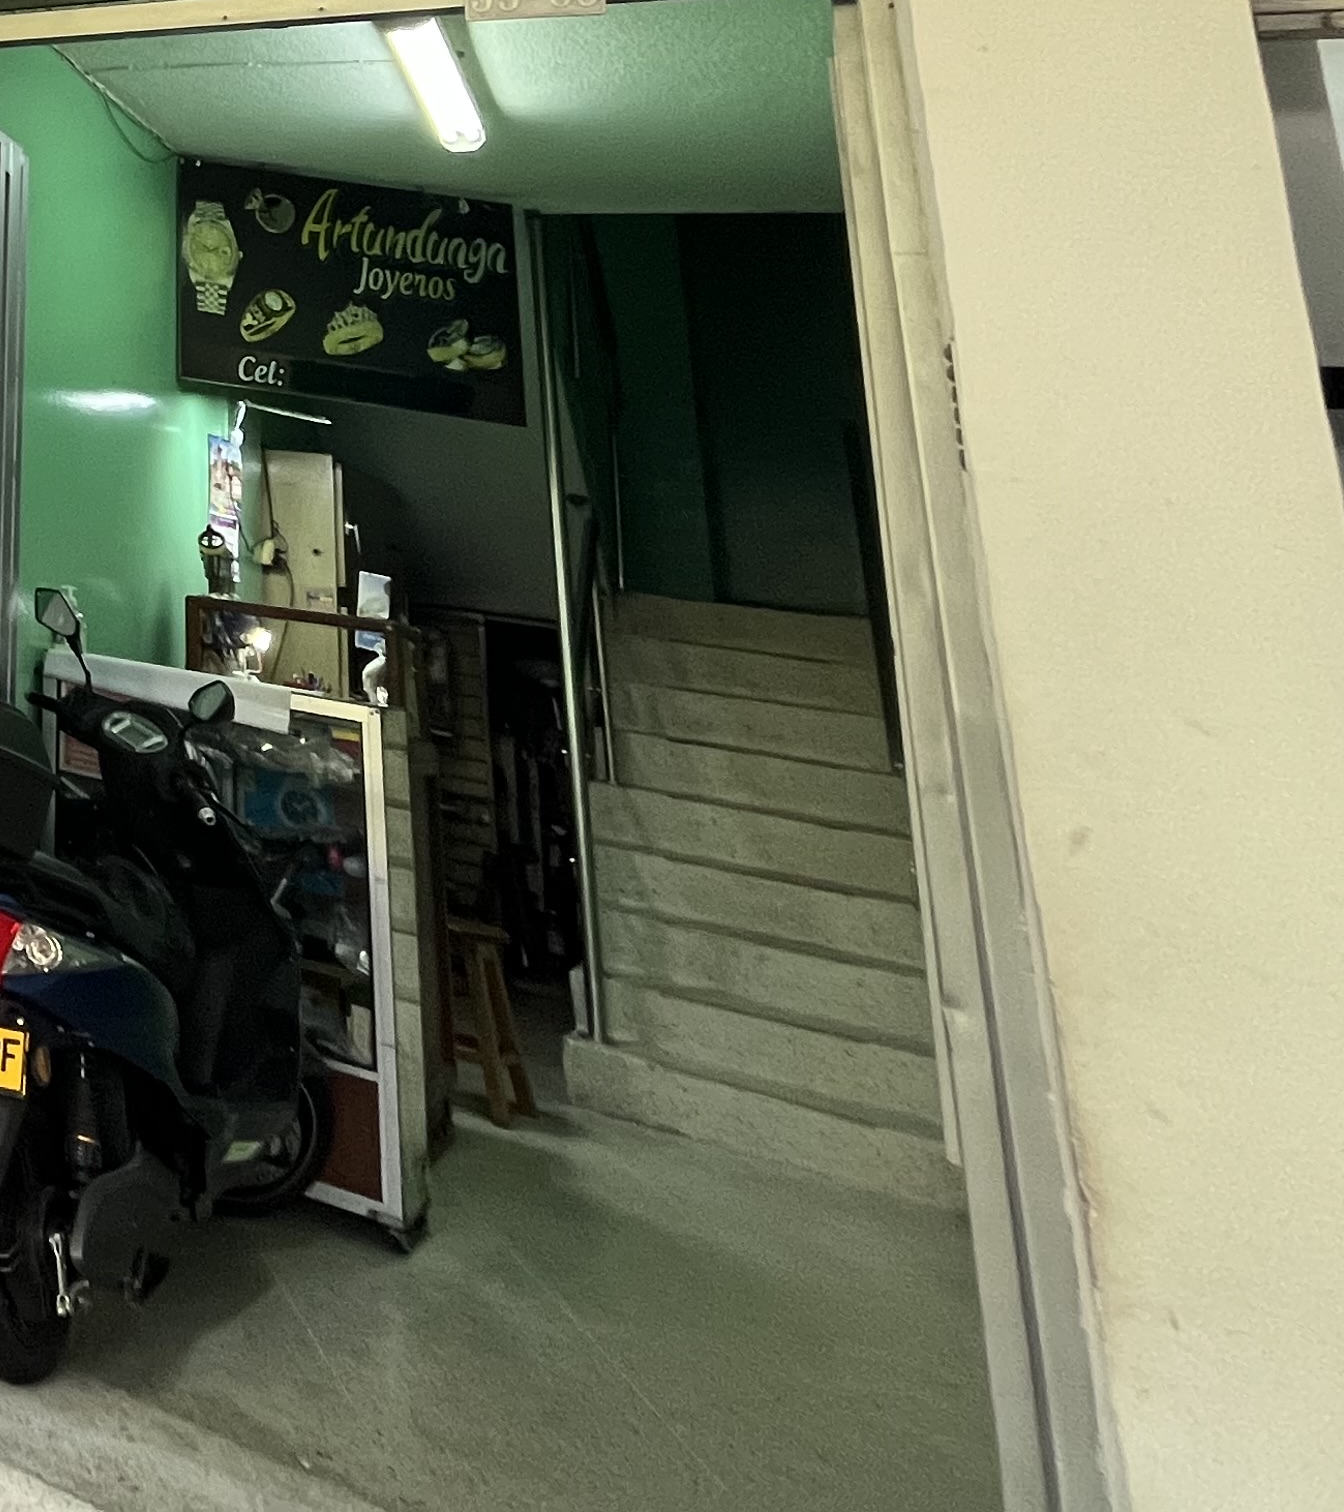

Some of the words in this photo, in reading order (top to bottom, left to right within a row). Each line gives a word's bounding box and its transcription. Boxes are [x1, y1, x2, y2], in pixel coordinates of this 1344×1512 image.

[301, 189, 510, 284] Artunduaga
[353, 257, 455, 301] Joyeros
[238, 357, 286, 386] Cel:
